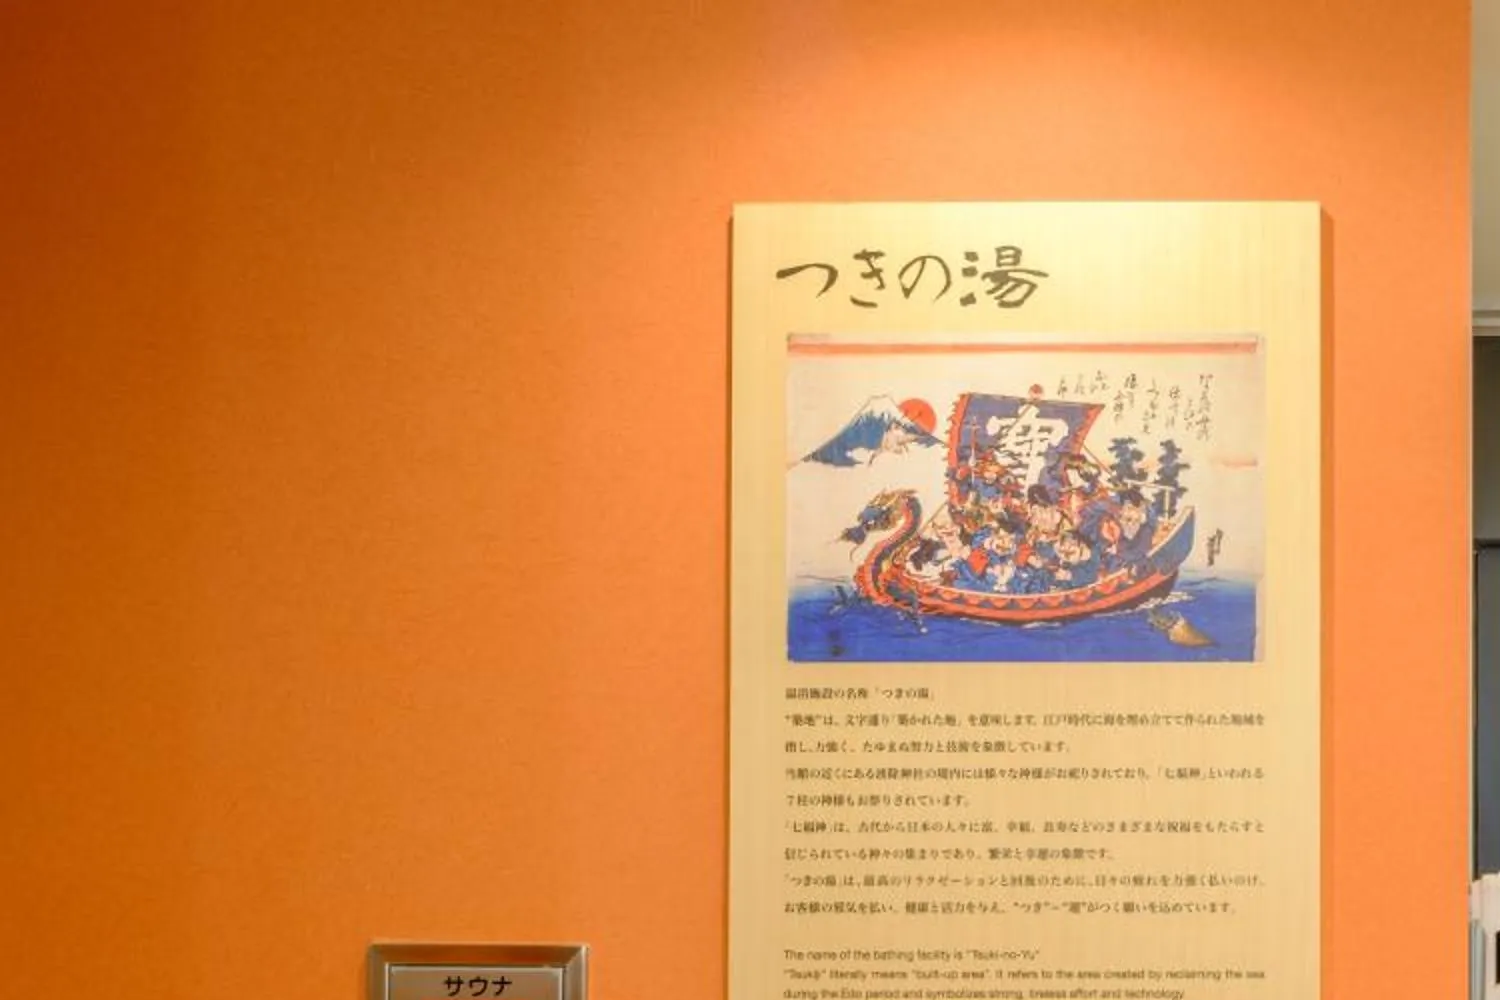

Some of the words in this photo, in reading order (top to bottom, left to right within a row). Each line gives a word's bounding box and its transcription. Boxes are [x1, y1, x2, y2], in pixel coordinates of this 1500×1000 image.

[776, 245, 1049, 309] つきの湯
[444, 975, 512, 997] サウナ
